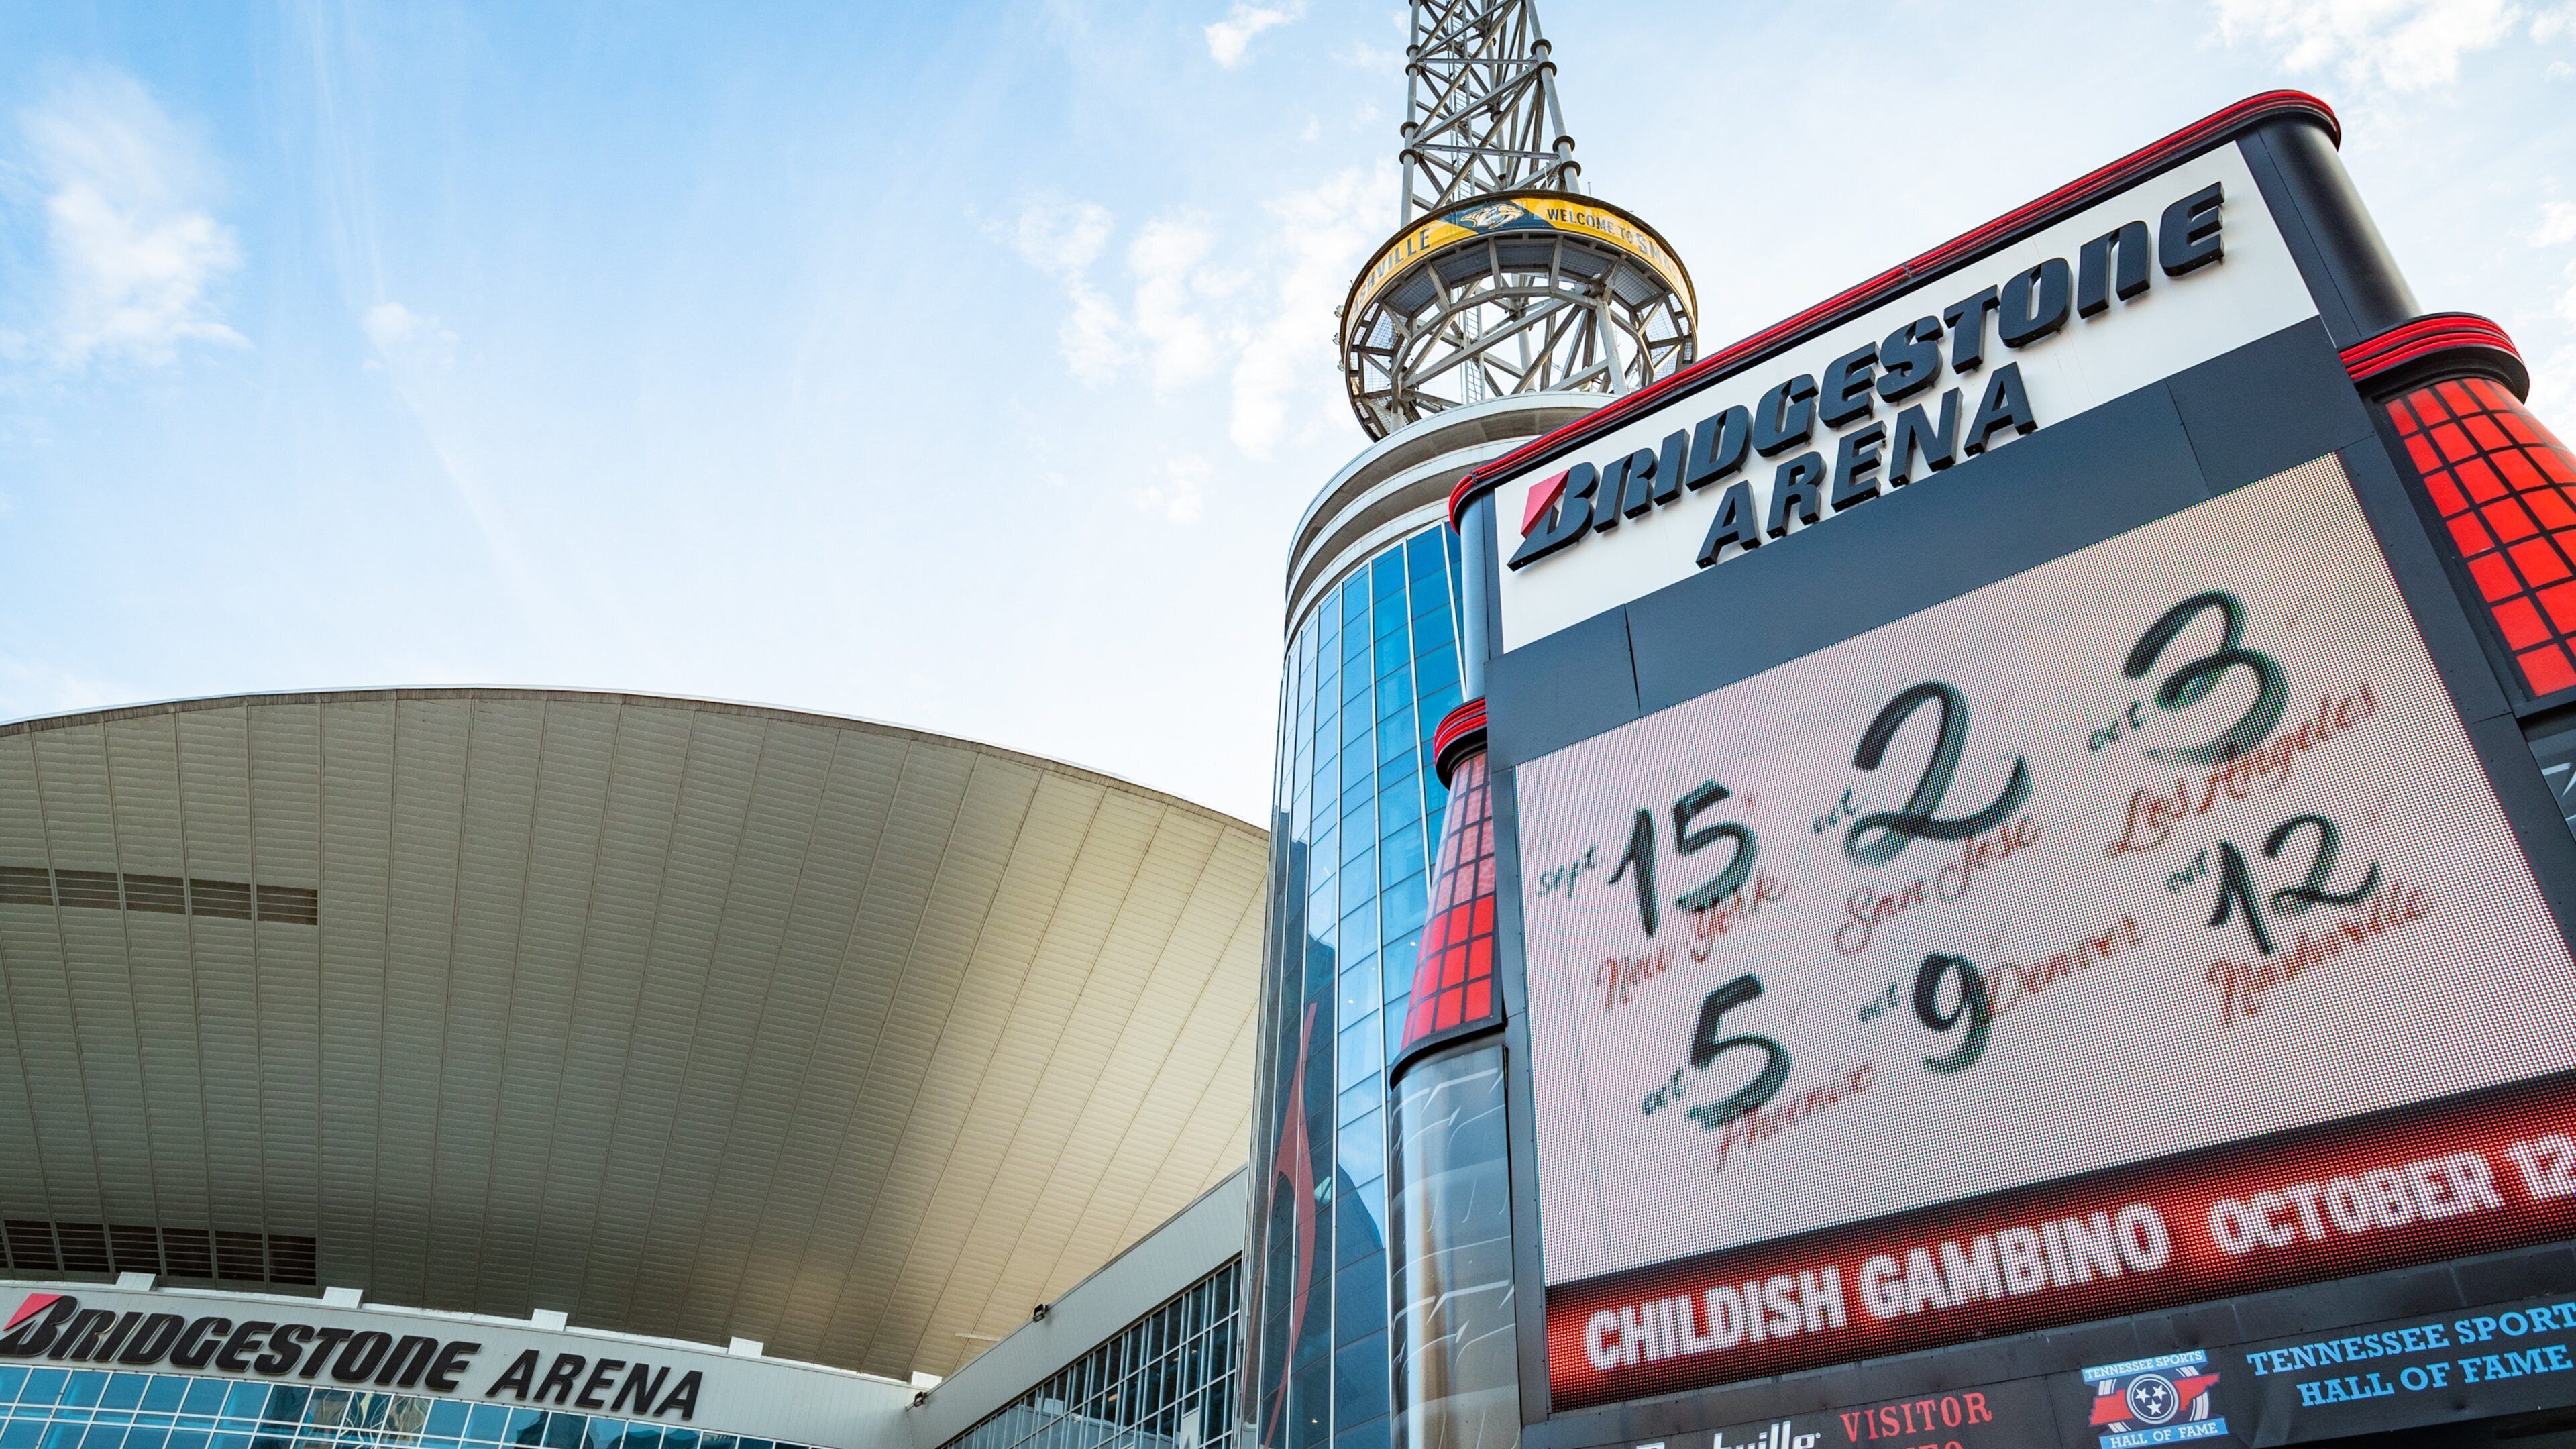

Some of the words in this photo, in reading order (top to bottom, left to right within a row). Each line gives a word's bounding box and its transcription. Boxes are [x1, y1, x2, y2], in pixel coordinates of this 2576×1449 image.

[1546, 209, 1615, 235] WELCOME
[1618, 225, 1633, 244] TO
[1506, 181, 2225, 571] BRIDGESTONE
[1695, 362, 2038, 568] ARENA
[2122, 590, 2288, 765] 3
[1845, 681, 2033, 867] 2
[2106, 780, 2190, 857] Los
[2196, 681, 2378, 814] Angeles
[1607, 779, 1757, 938] 15
[1835, 881, 1927, 955] San
[2207, 814, 2380, 957] 12
[1594, 946, 1675, 1013] New
[1687, 871, 1789, 965] York
[1984, 915, 2143, 1016] Denver
[2205, 881, 2431, 1027] Nashville
[1685, 973, 1791, 1130] 5
[1912, 952, 1994, 1075] 9
[1715, 1063, 1876, 1174] Phoenix
[1583, 1264, 1849, 1372] CHILDISH
[1858, 1202, 2171, 1320] GAMBINO
[2208, 1150, 2505, 1256] OCTOBER
[0, 1293, 482, 1391] BRIDGESTONE
[484, 1349, 704, 1421] ARENA
[1839, 1392, 1992, 1443] VISITOR
[2084, 1359, 2153, 1379] TENNESSEE
[2155, 1350, 2204, 1368] SPORTS
[2245, 1323, 2451, 1377] TENNESSEE
[2296, 1372, 2395, 1407] HALL
[2400, 1362, 2451, 1391] OF
[2457, 1344, 2574, 1384] FAME
[2110, 1433, 2148, 1448] HALL
[2153, 1430, 2172, 1442] OF
[2178, 1423, 2218, 1439] FAME
